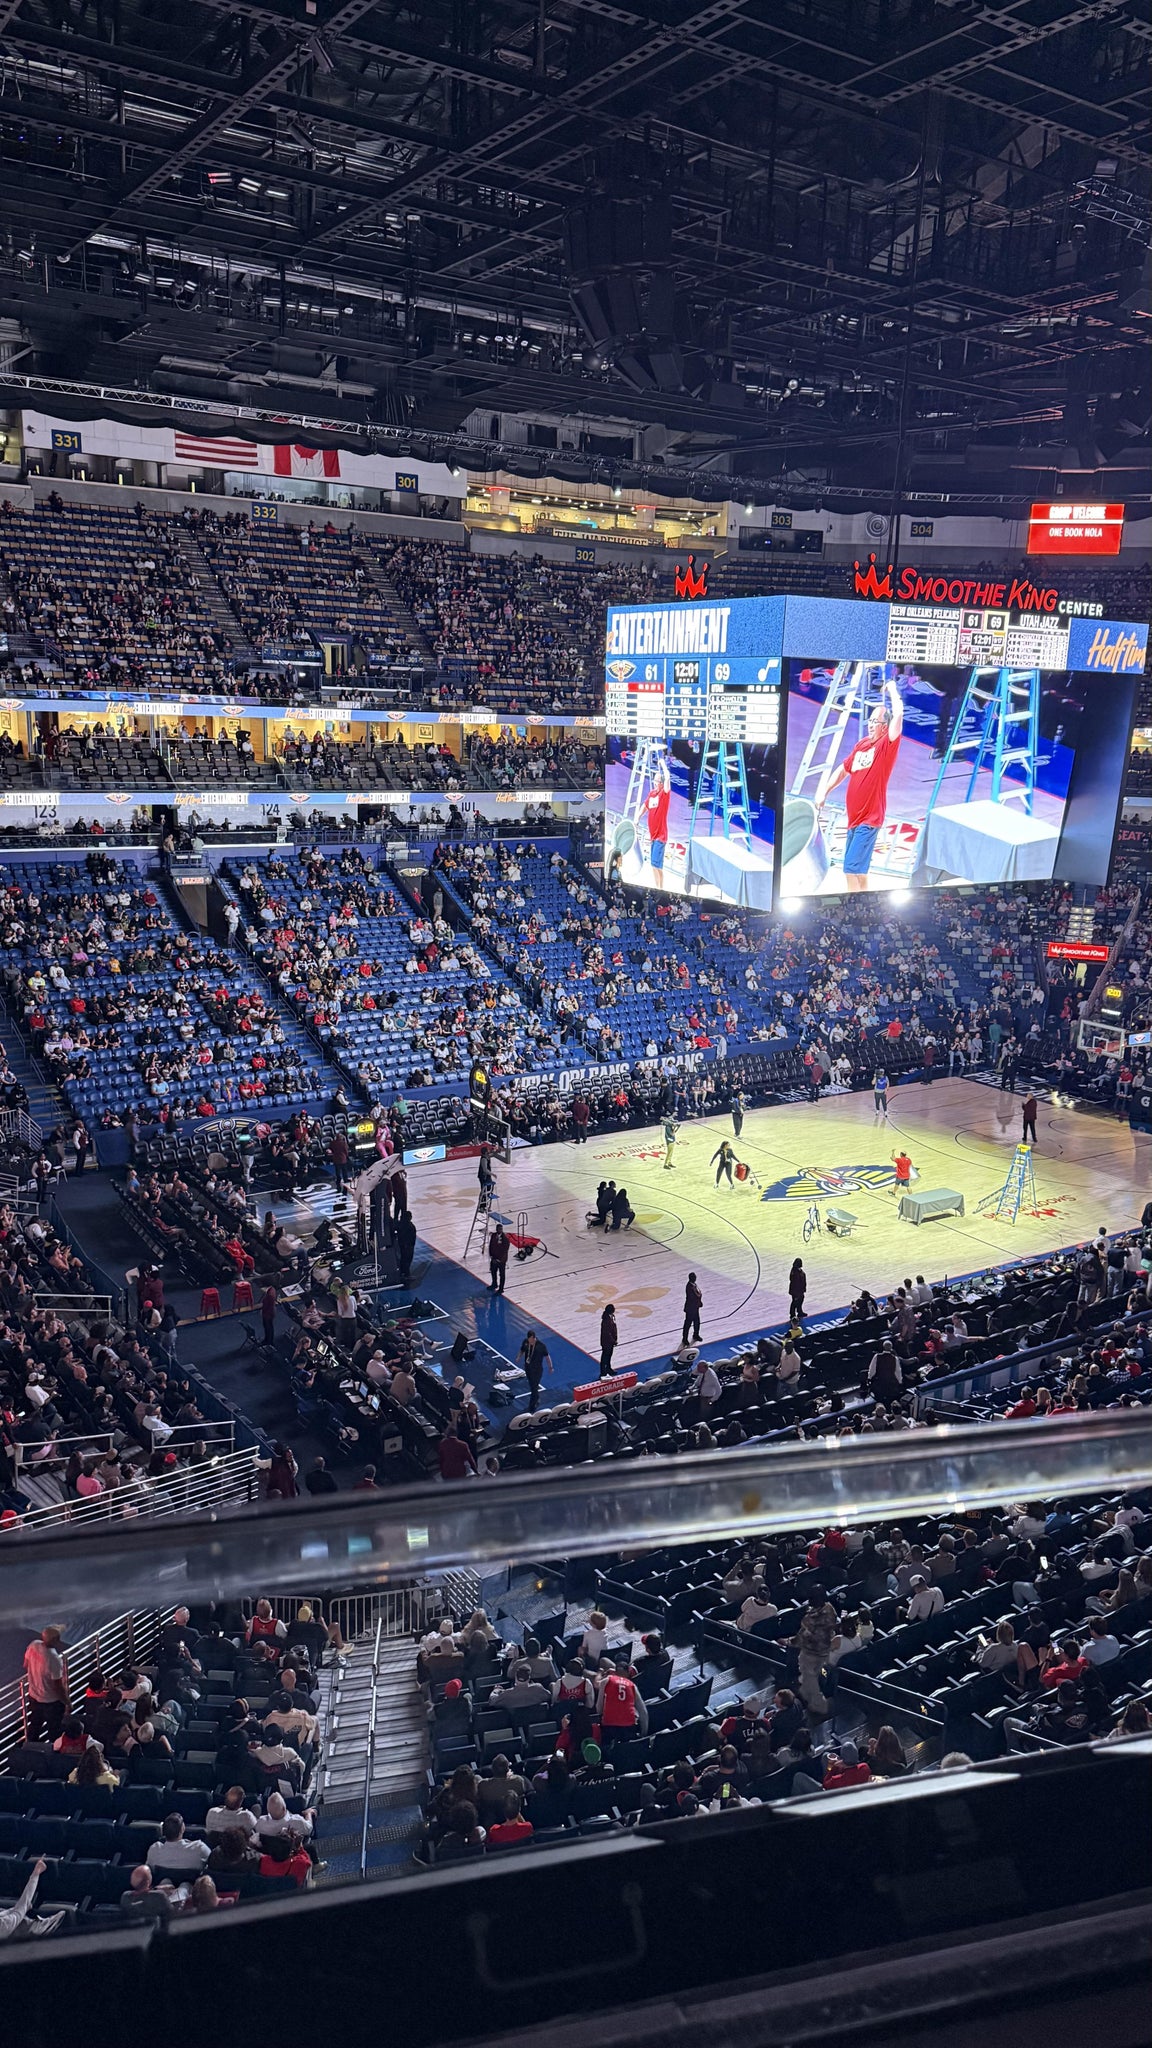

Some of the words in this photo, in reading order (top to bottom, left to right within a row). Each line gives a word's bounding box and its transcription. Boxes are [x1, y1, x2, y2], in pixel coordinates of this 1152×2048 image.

[54, 434, 79, 449] 331
[397, 476, 417, 490] 301
[253, 505, 277, 520] 332
[772, 515, 791, 526] 303
[912, 524, 932, 535] 304
[1049, 528, 1062, 537] ONE
[1064, 528, 1083, 537] BOOK
[1085, 528, 1103, 537] NOLA
[576, 549, 595, 561] 302
[897, 567, 1007, 607] SMOOTHIE
[1058, 601, 1103, 616] CENTER
[891, 606, 907, 616] NEW
[907, 607, 932, 618] ORLEANS
[933, 609, 960, 620] PELICANS
[968, 614, 979, 627] 61
[991, 616, 1002, 629] 69
[1020, 614, 1040, 627] UTAH
[1040, 616, 1059, 629] JAZZ
[611, 607, 731, 655] ENTERTAINMENT
[973, 634, 992, 646] 12:01
[645, 664, 658, 681] 61
[674, 662, 699, 678] 12:01
[714, 663, 730, 681] 69
[33, 804, 57, 818] 123
[261, 803, 280, 816] 124
[359, 1264, 377, 1275] Ford
[687, 1352, 696, 1361] G
[591, 1381, 625, 1395] GATORADE
[518, 1418, 528, 1428] G
[618, 1685, 626, 1701] 5
